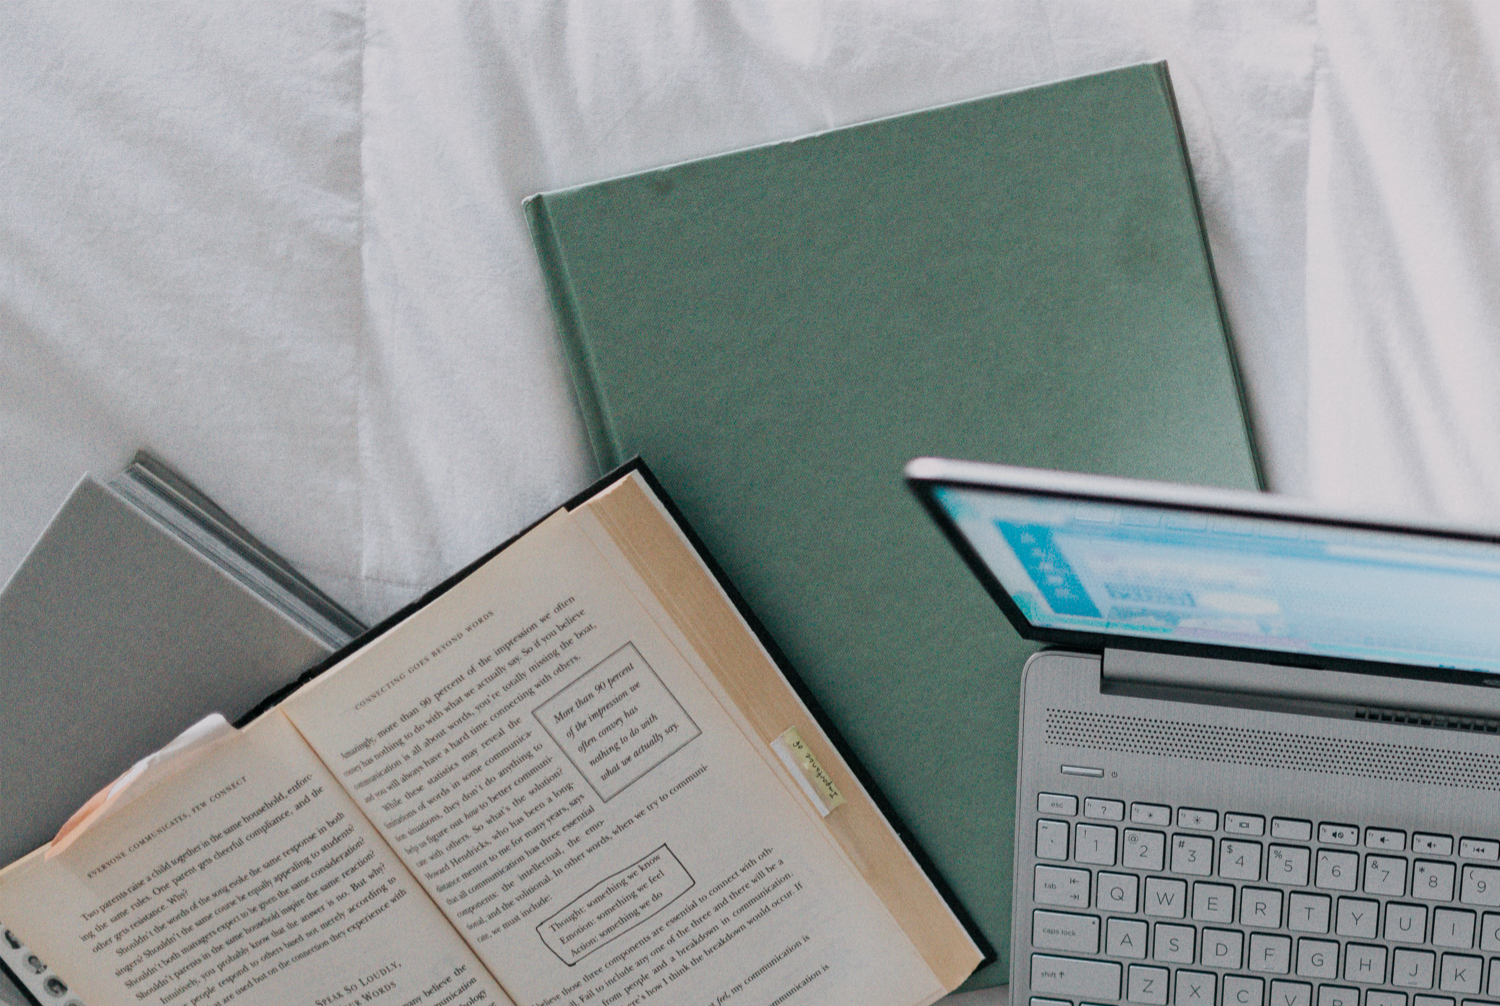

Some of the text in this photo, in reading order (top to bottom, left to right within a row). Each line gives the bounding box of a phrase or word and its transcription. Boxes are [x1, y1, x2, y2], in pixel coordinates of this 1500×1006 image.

[355, 611, 494, 710] CONNECTING GOES BEYOND WORDS
[553, 662, 634, 724] More than 90 percent
[566, 682, 640, 739] of the impression we
[578, 706, 638, 753] often convey has
[589, 713, 658, 767] nothing to do with
[600, 723, 679, 781] what we actually say.
[87, 776, 246, 879] EVERYONE COMMUNICATES, FEW CONNECT
[1139, 844, 1149, 858] 2
[1188, 849, 1196, 863] 3
[1235, 855, 1244, 867] 4
[1284, 859, 1293, 873] 5
[1331, 865, 1341, 878] 6
[1381, 869, 1390, 882] 7
[1428, 875, 1438, 888] 8
[1477, 880, 1487, 893] 9
[549, 855, 660, 932] Thought: something we know
[1110, 886, 1125, 901] Q
[1156, 892, 1175, 906] W
[559, 869, 665, 945] Emotion: something we feel
[1207, 896, 1218, 911] E
[1254, 901, 1267, 916] R
[1304, 906, 1314, 920] T
[1351, 912, 1364, 926] Y
[571, 892, 663, 957] Action: something we do
[1399, 917, 1412, 932] U
[1120, 933, 1133, 947] A
[1169, 937, 1180, 952] S
[1215, 942, 1229, 957] D
[1264, 947, 1275, 961] F
[1310, 952, 1324, 967] G
[1359, 958, 1372, 971] H
[1409, 963, 1419, 977] J
[1454, 968, 1466, 982] K
[344, 984, 358, 994] SO
[1142, 979, 1154, 994] Z
[1190, 984, 1201, 998] X
[1236, 989, 1249, 1004] C
